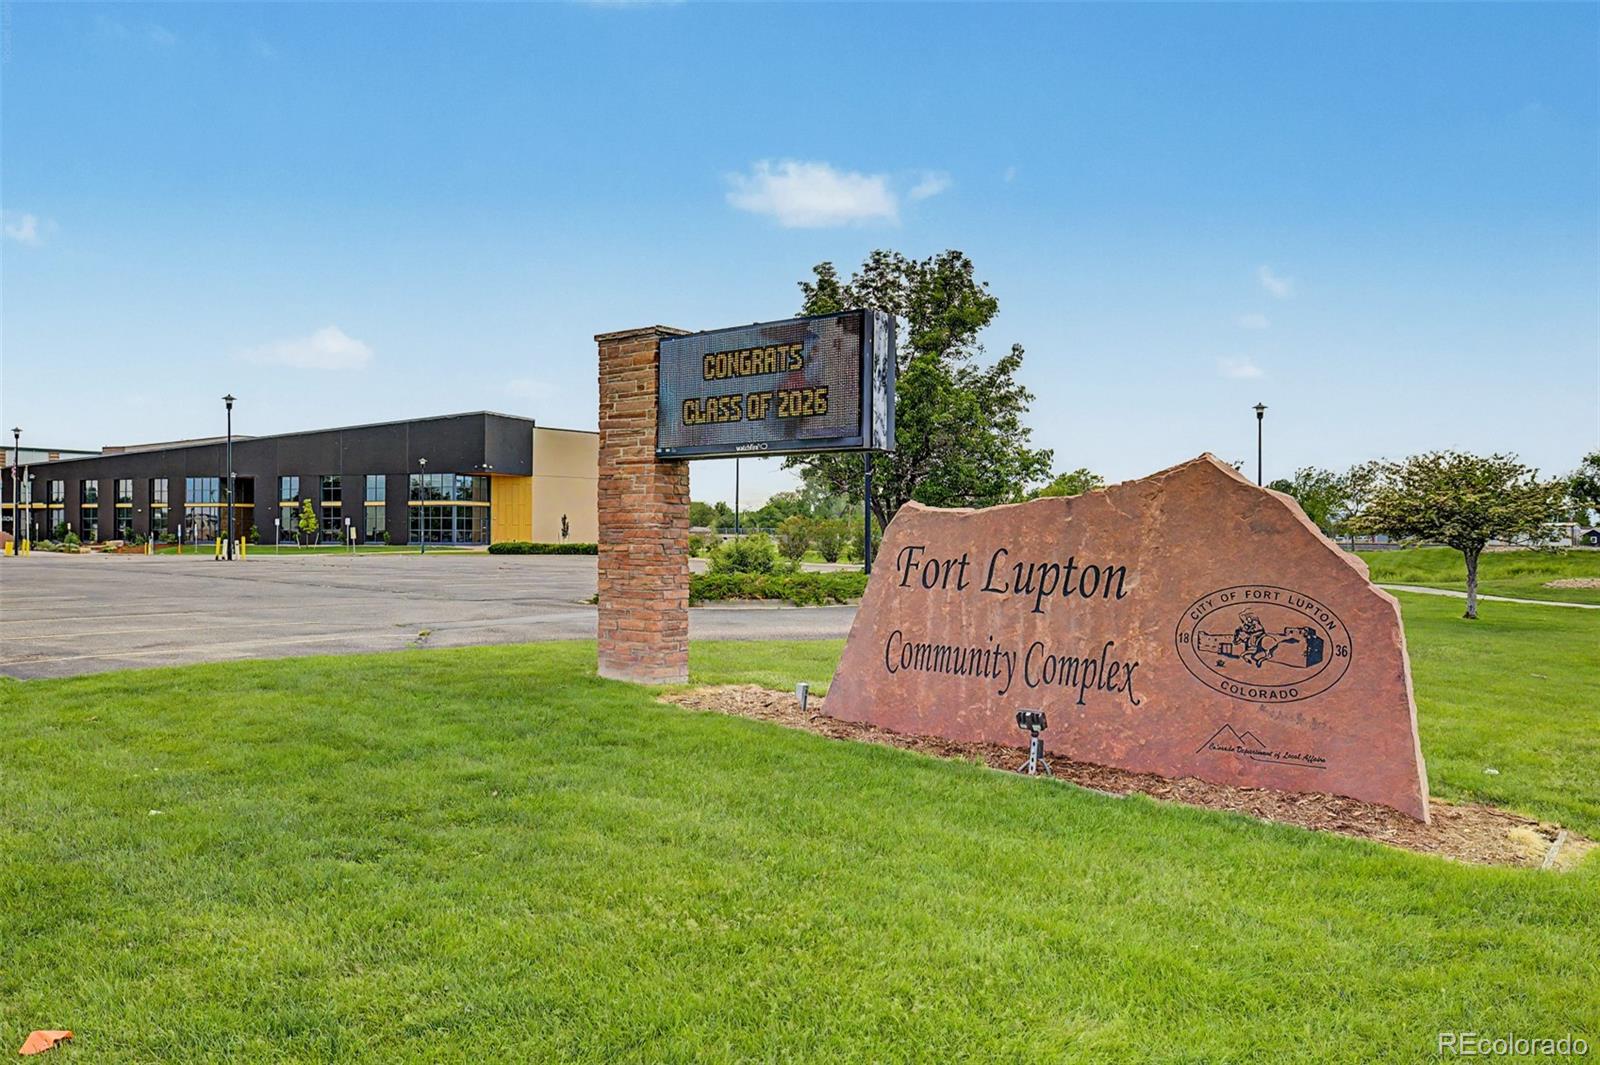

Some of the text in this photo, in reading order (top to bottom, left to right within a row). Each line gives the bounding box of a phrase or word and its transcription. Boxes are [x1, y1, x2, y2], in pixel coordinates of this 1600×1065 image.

[703, 342, 804, 381] CONGRATS
[683, 386, 828, 426] CLASS OF 2026
[896, 545, 1127, 614] Fort Lupton
[1190, 590, 1337, 631] CITY OF FORT LUPTON
[1178, 632, 1190, 644] 18
[1335, 645, 1348, 658] 36
[885, 630, 1141, 706] Community Complex
[1220, 680, 1299, 699] COLORADO
[1274, 752, 1281, 760] of
